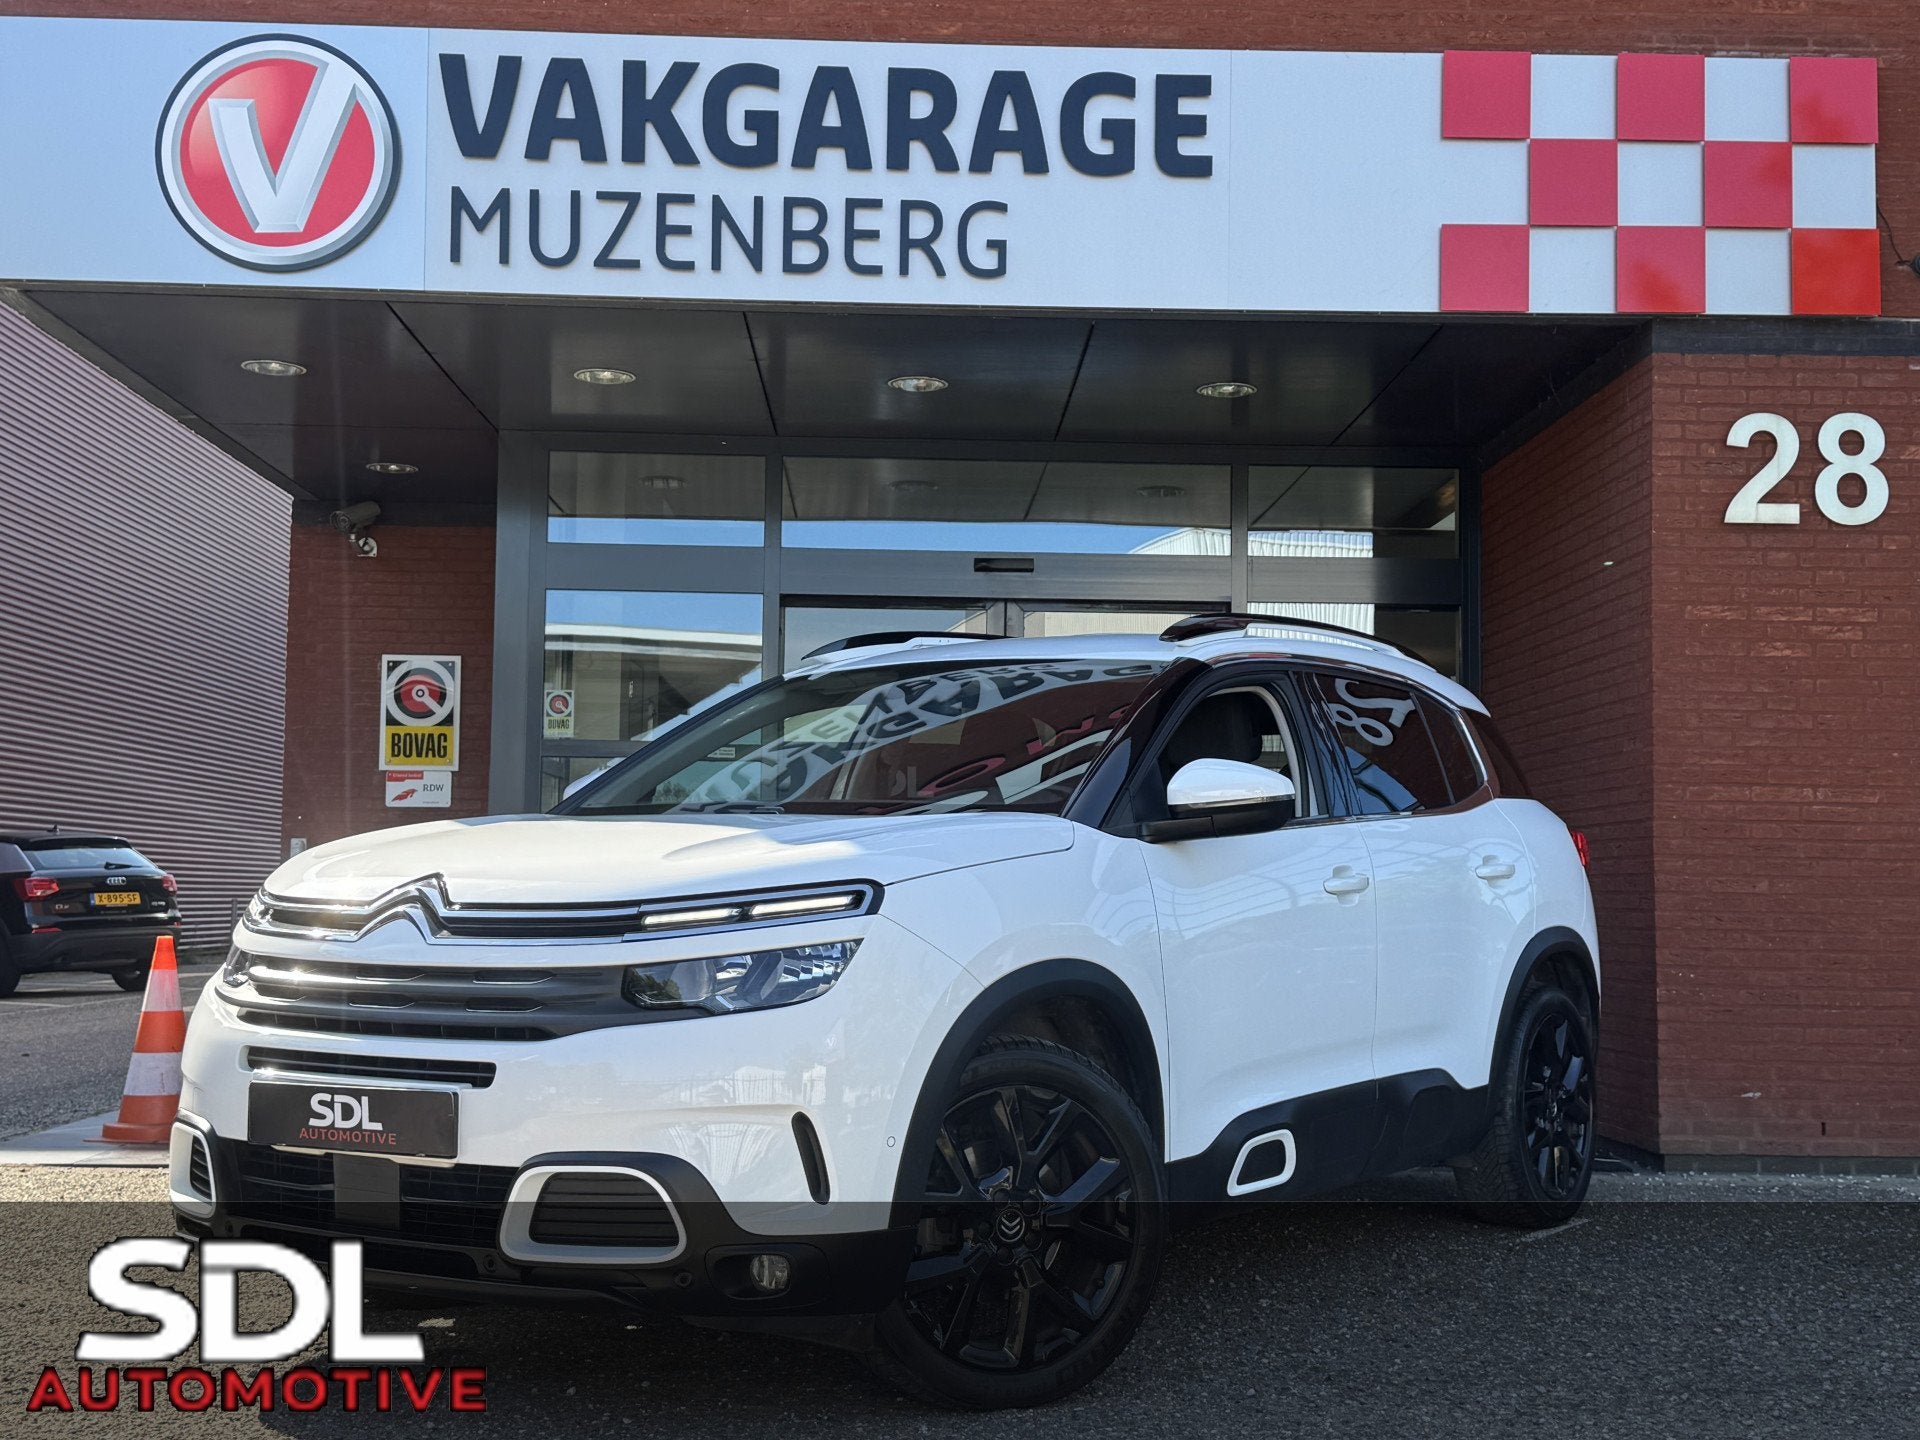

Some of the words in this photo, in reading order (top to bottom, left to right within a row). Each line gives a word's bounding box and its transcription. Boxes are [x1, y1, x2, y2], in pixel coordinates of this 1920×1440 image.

[439, 53, 1213, 178] VAKGARAGE
[450, 185, 1009, 279] MUZENBERG
[1724, 412, 1890, 526] 28
[391, 732, 448, 759] BOVAG
[422, 783, 444, 792] RDW
[308, 1092, 383, 1131] SDL
[299, 1127, 397, 1145] AUTOMOTIVE
